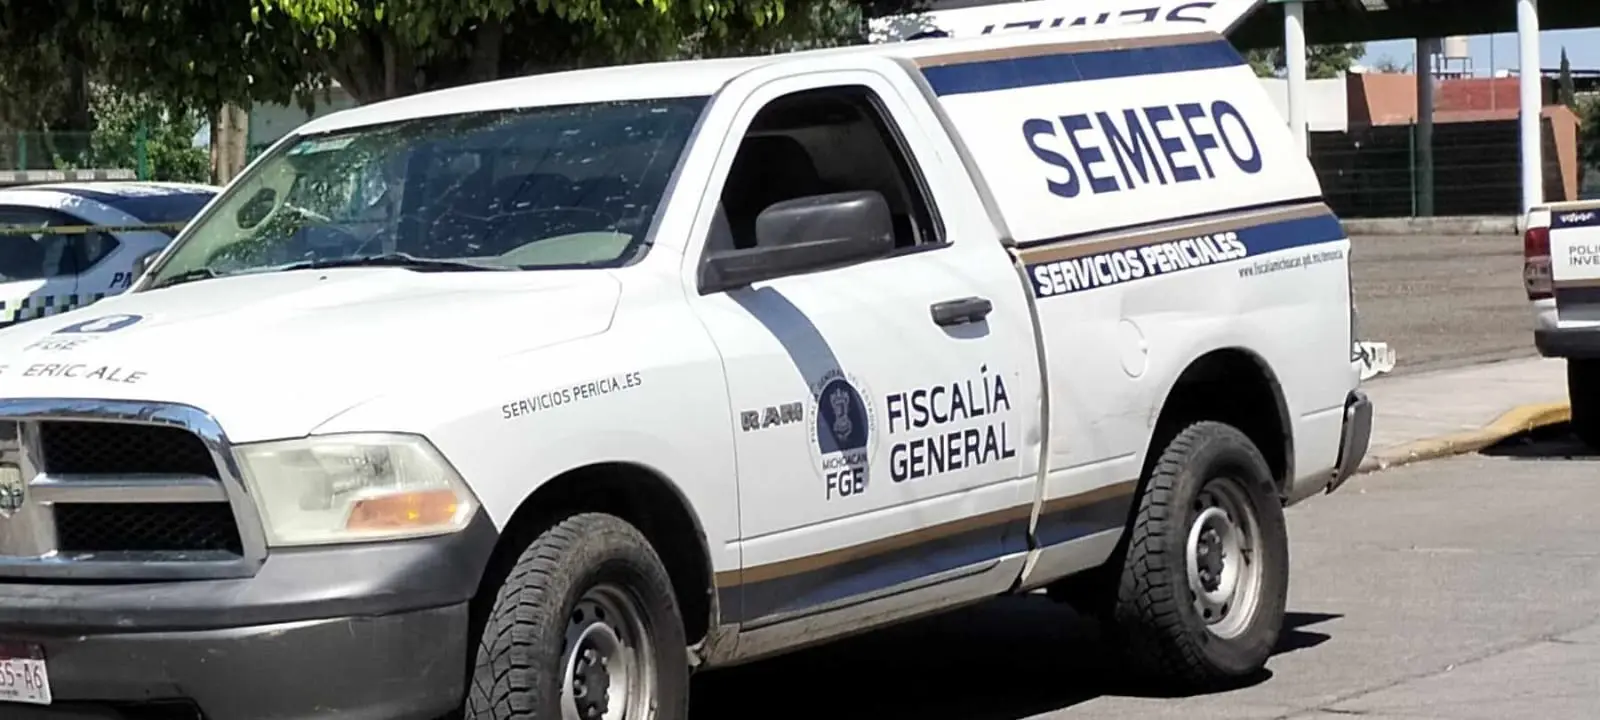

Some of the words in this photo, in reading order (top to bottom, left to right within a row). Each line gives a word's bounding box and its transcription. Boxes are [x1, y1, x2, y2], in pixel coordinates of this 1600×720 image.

[1022, 100, 1262, 198] SEMEFO
[1034, 249, 1144, 296] SERVICIOS
[1142, 231, 1247, 275] PERICIALES
[1569, 245, 1600, 255] POLI
[502, 389, 571, 419] SERVICIOS
[740, 401, 803, 431] RAM
[886, 364, 1011, 433] FISCALÍA
[890, 421, 1015, 483] GENERAL
[826, 467, 865, 500] FGE
